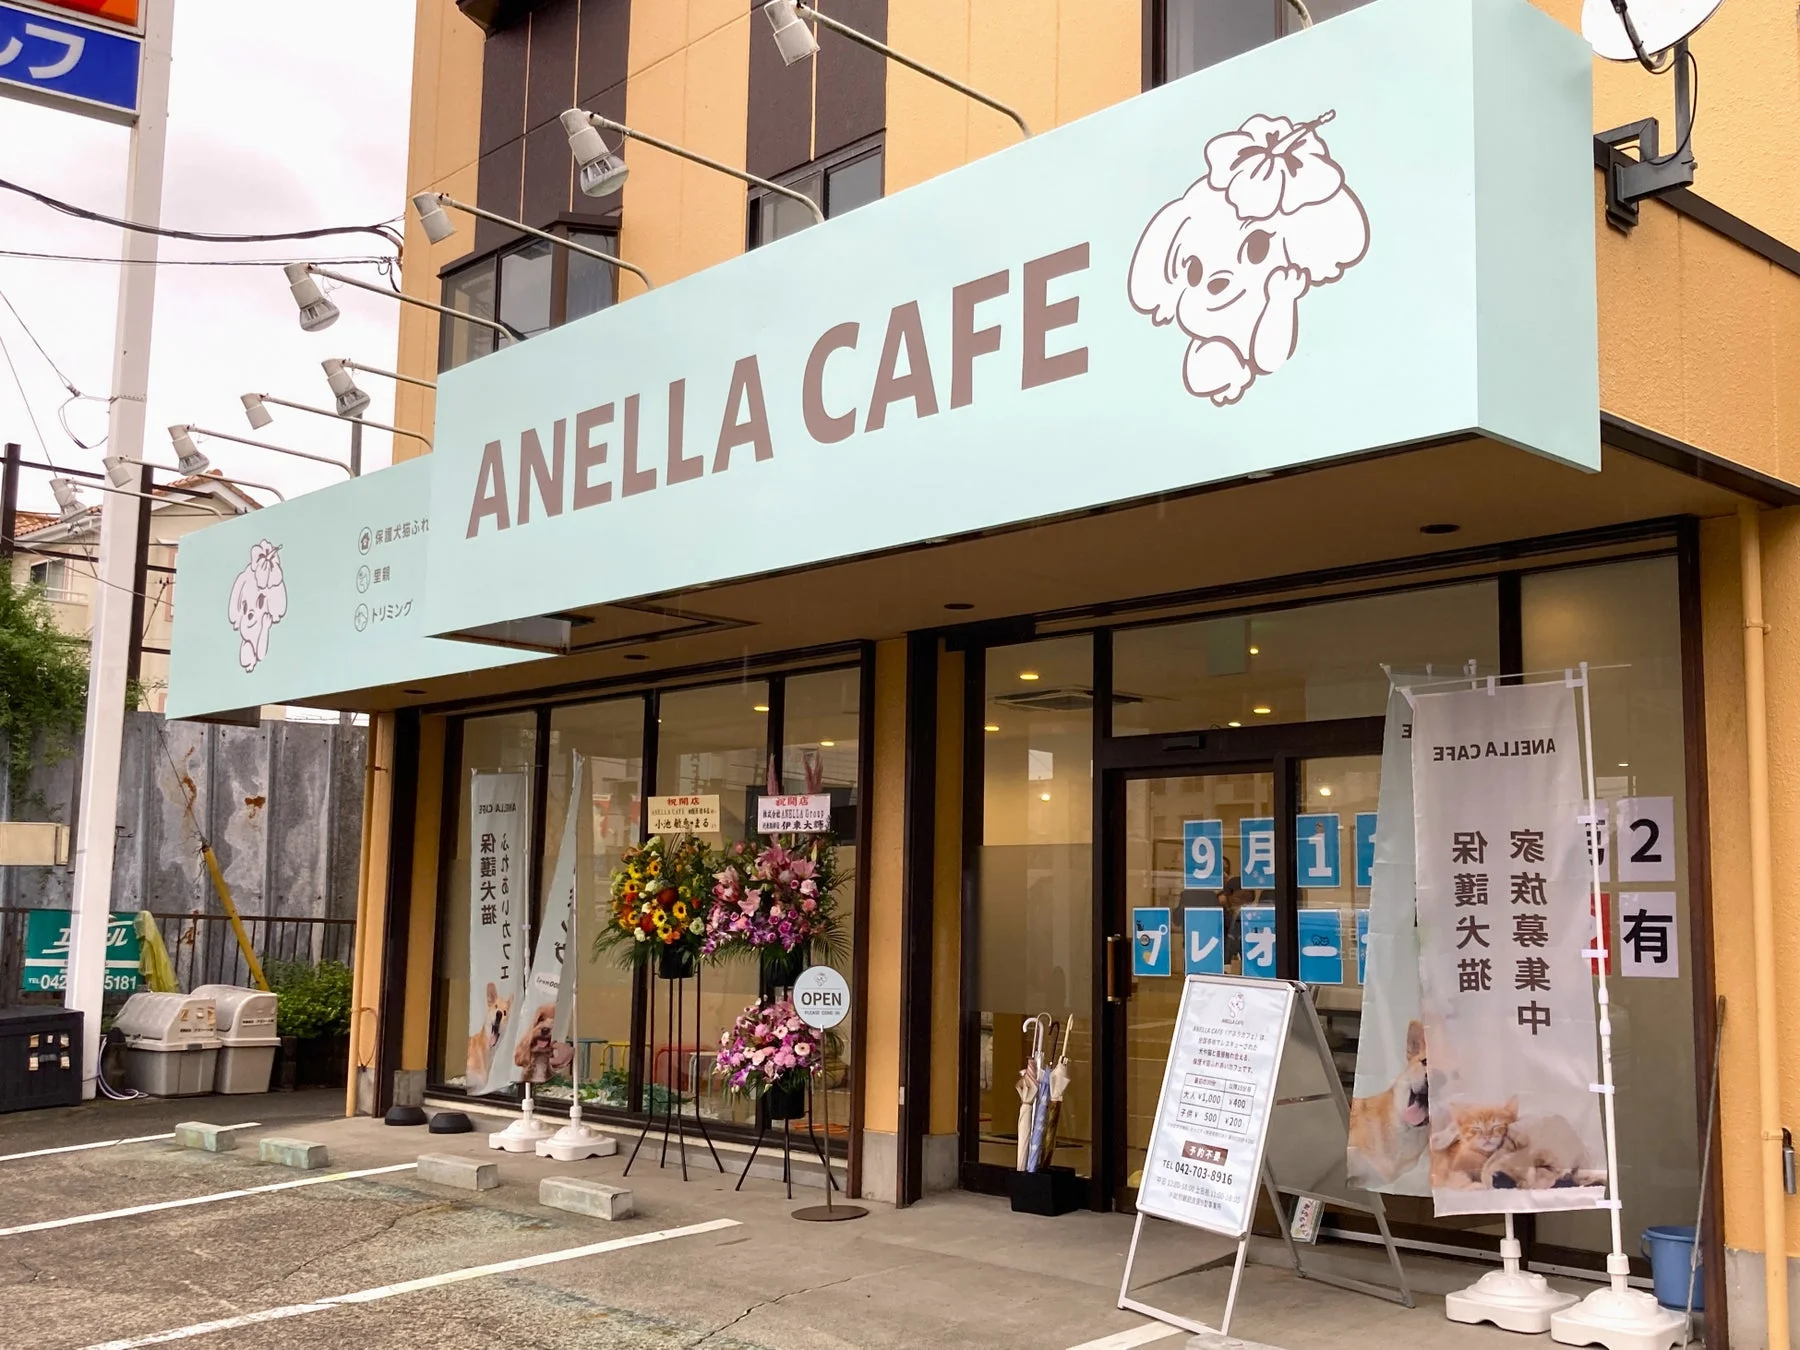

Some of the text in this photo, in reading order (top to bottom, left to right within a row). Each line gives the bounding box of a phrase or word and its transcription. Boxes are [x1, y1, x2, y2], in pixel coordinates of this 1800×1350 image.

[465, 241, 1091, 539] ANELLA CAFE
[373, 566, 391, 584] 里親
[371, 599, 413, 623] トリミング
[667, 797, 700, 806] 祝開店
[776, 796, 809, 806] 祝開店
[1622, 909, 1673, 964] 有
[801, 992, 842, 1006] OPEN
[1183, 1091, 1195, 1100] 大人
[1180, 1108, 1192, 1118] 子供
[1204, 1112, 1217, 1122] 500
[1188, 1145, 1222, 1162] 予約不要
[1163, 1159, 1233, 1185] TEL 042-703-8916
